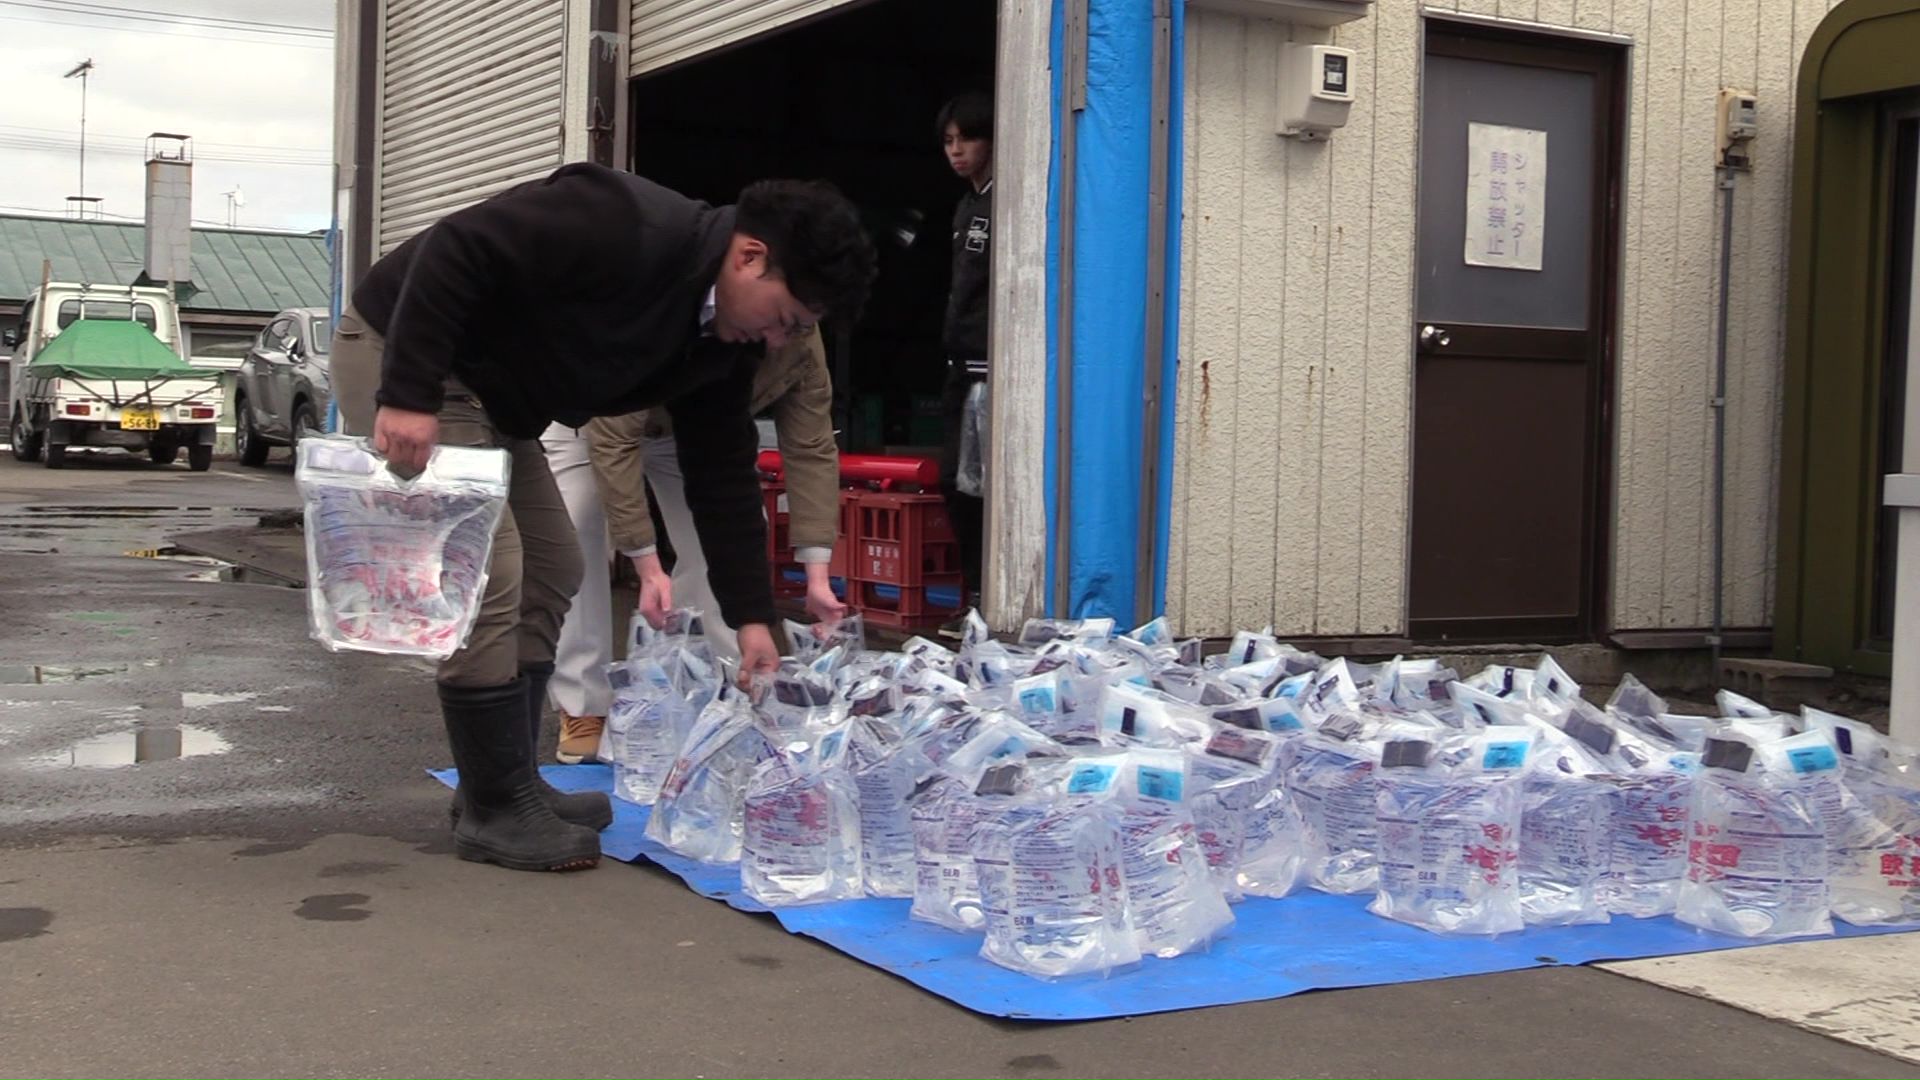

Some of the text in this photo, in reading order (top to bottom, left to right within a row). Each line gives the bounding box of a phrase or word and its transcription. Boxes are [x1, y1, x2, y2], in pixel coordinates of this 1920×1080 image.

[1512, 153, 1527, 256] シャッター
